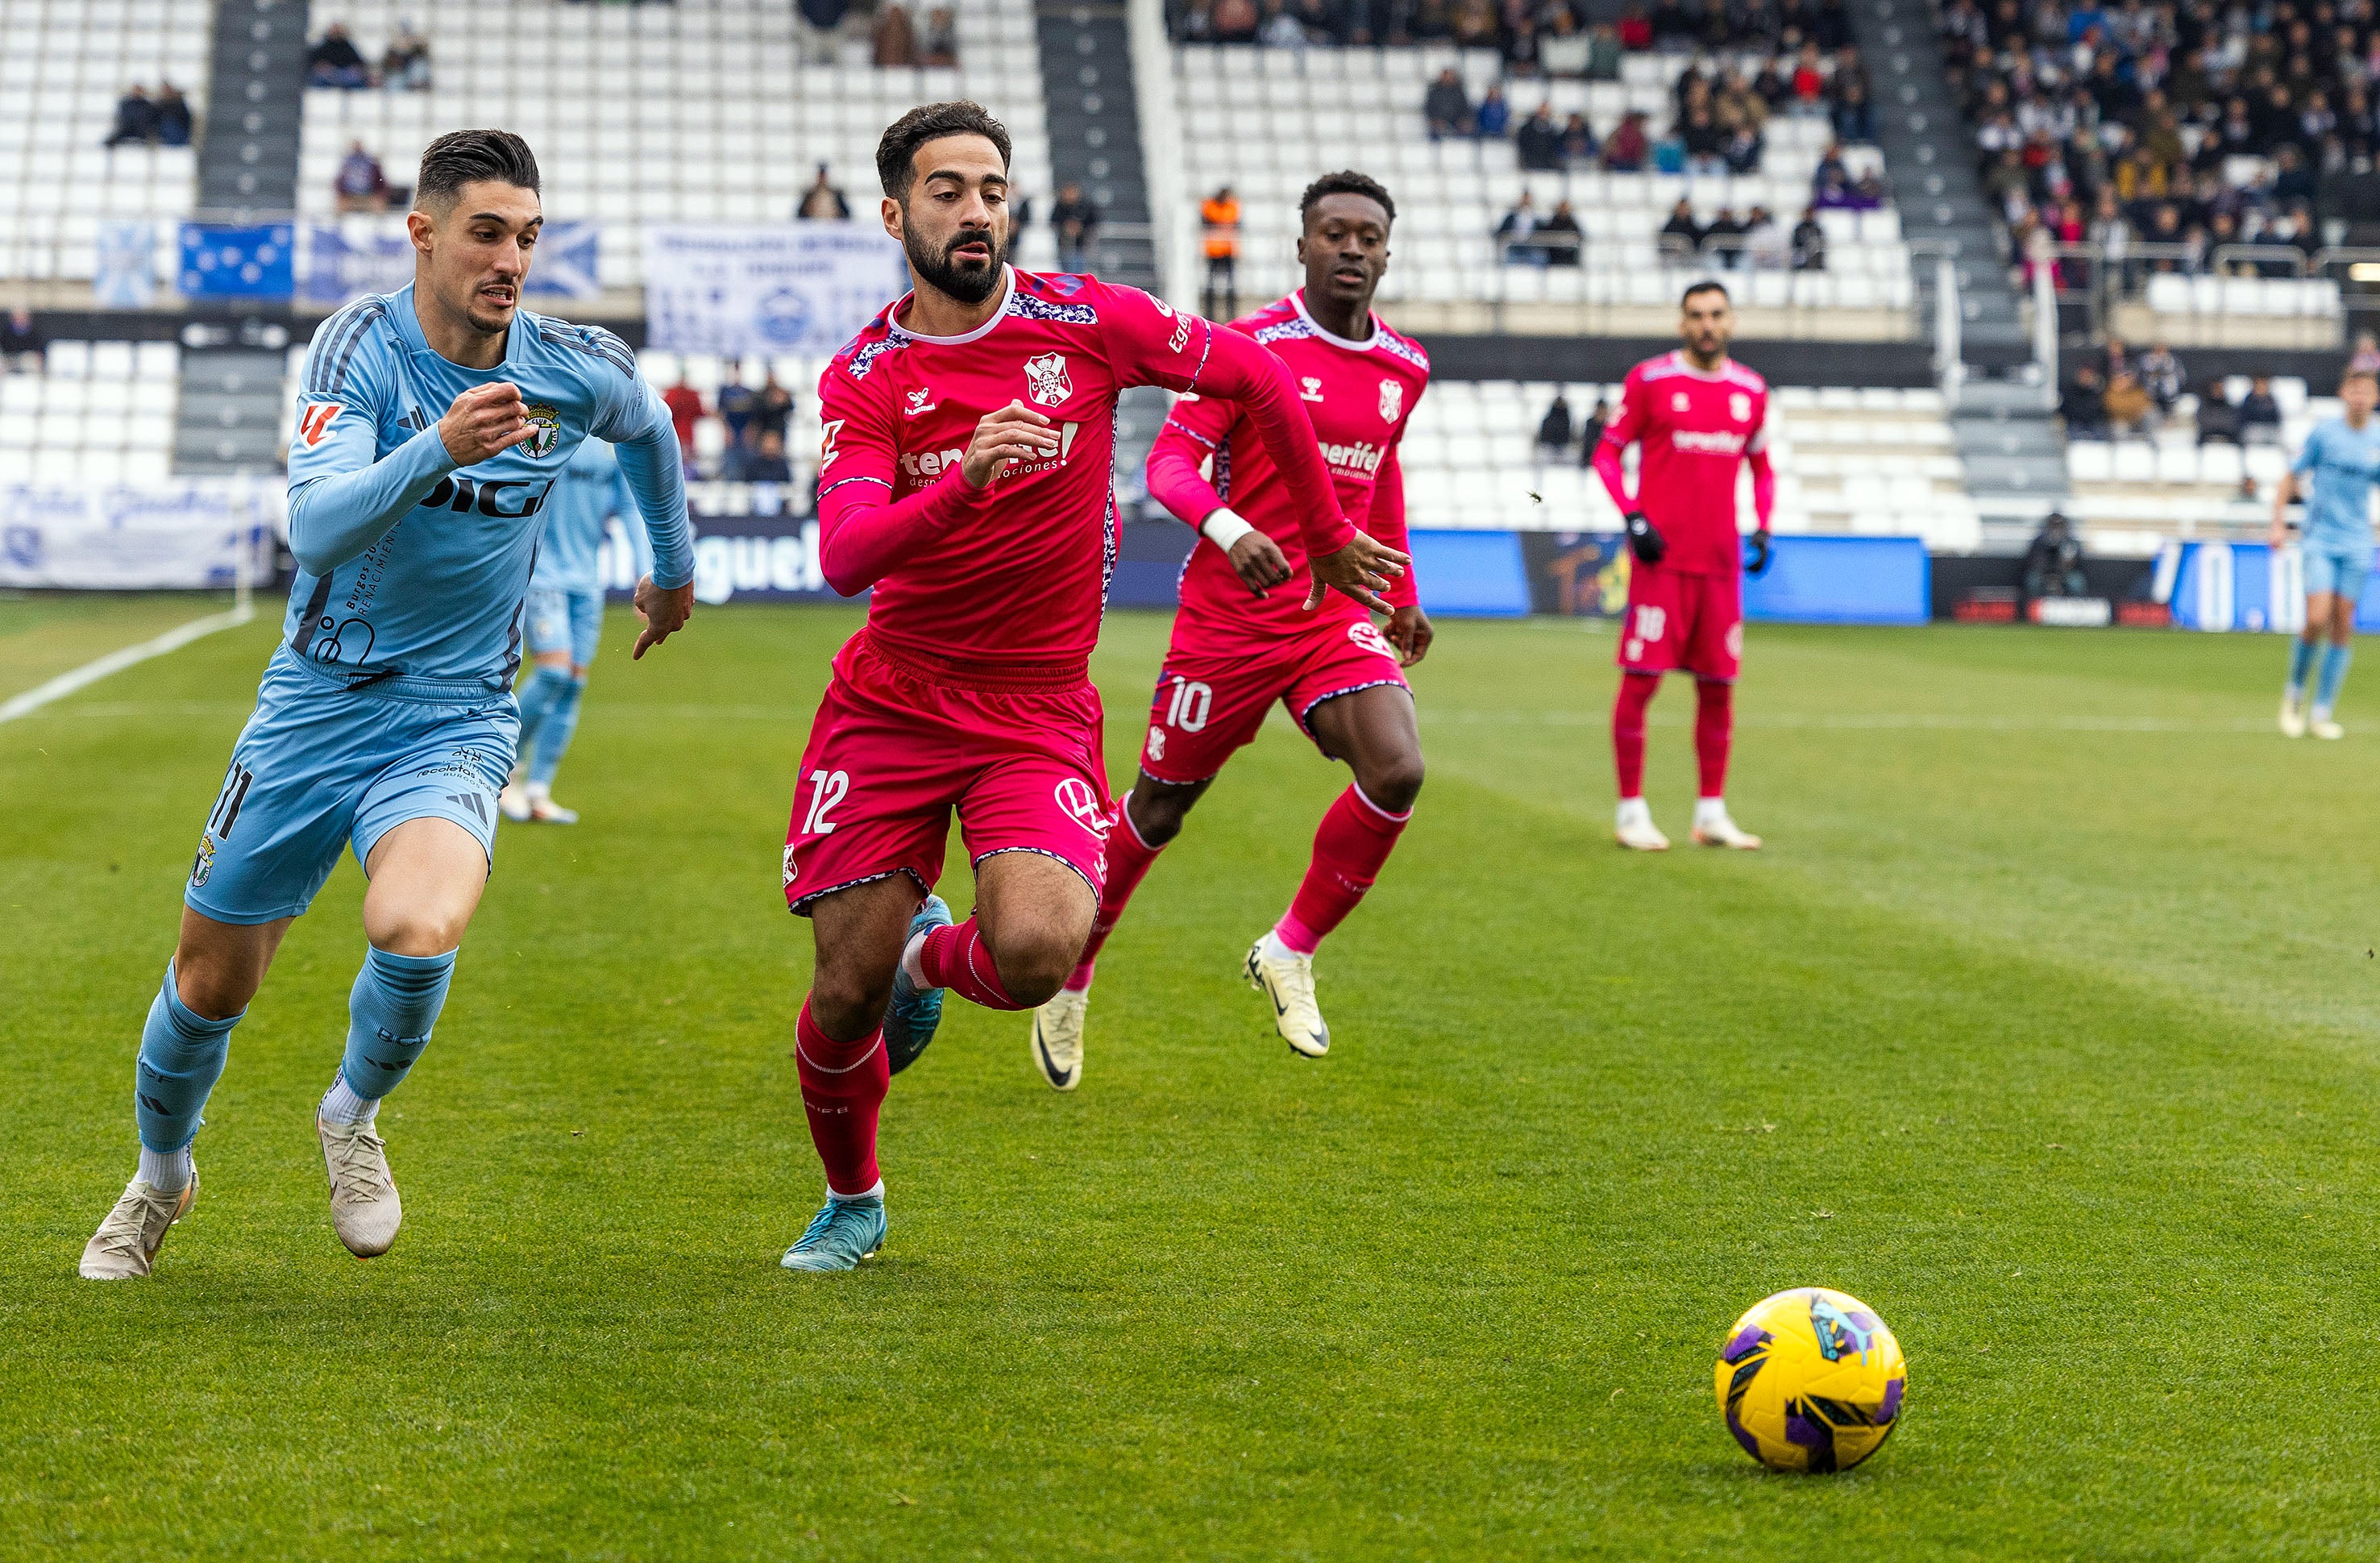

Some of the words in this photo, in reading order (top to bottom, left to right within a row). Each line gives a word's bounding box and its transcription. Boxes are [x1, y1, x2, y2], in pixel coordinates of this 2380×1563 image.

[346, 566, 370, 610] Burgos
[1165, 675, 1213, 734] 10
[416, 764, 476, 779] recoletas
[442, 771, 481, 789] BURGOS
[209, 759, 255, 842] 11
[800, 769, 849, 835] 12
